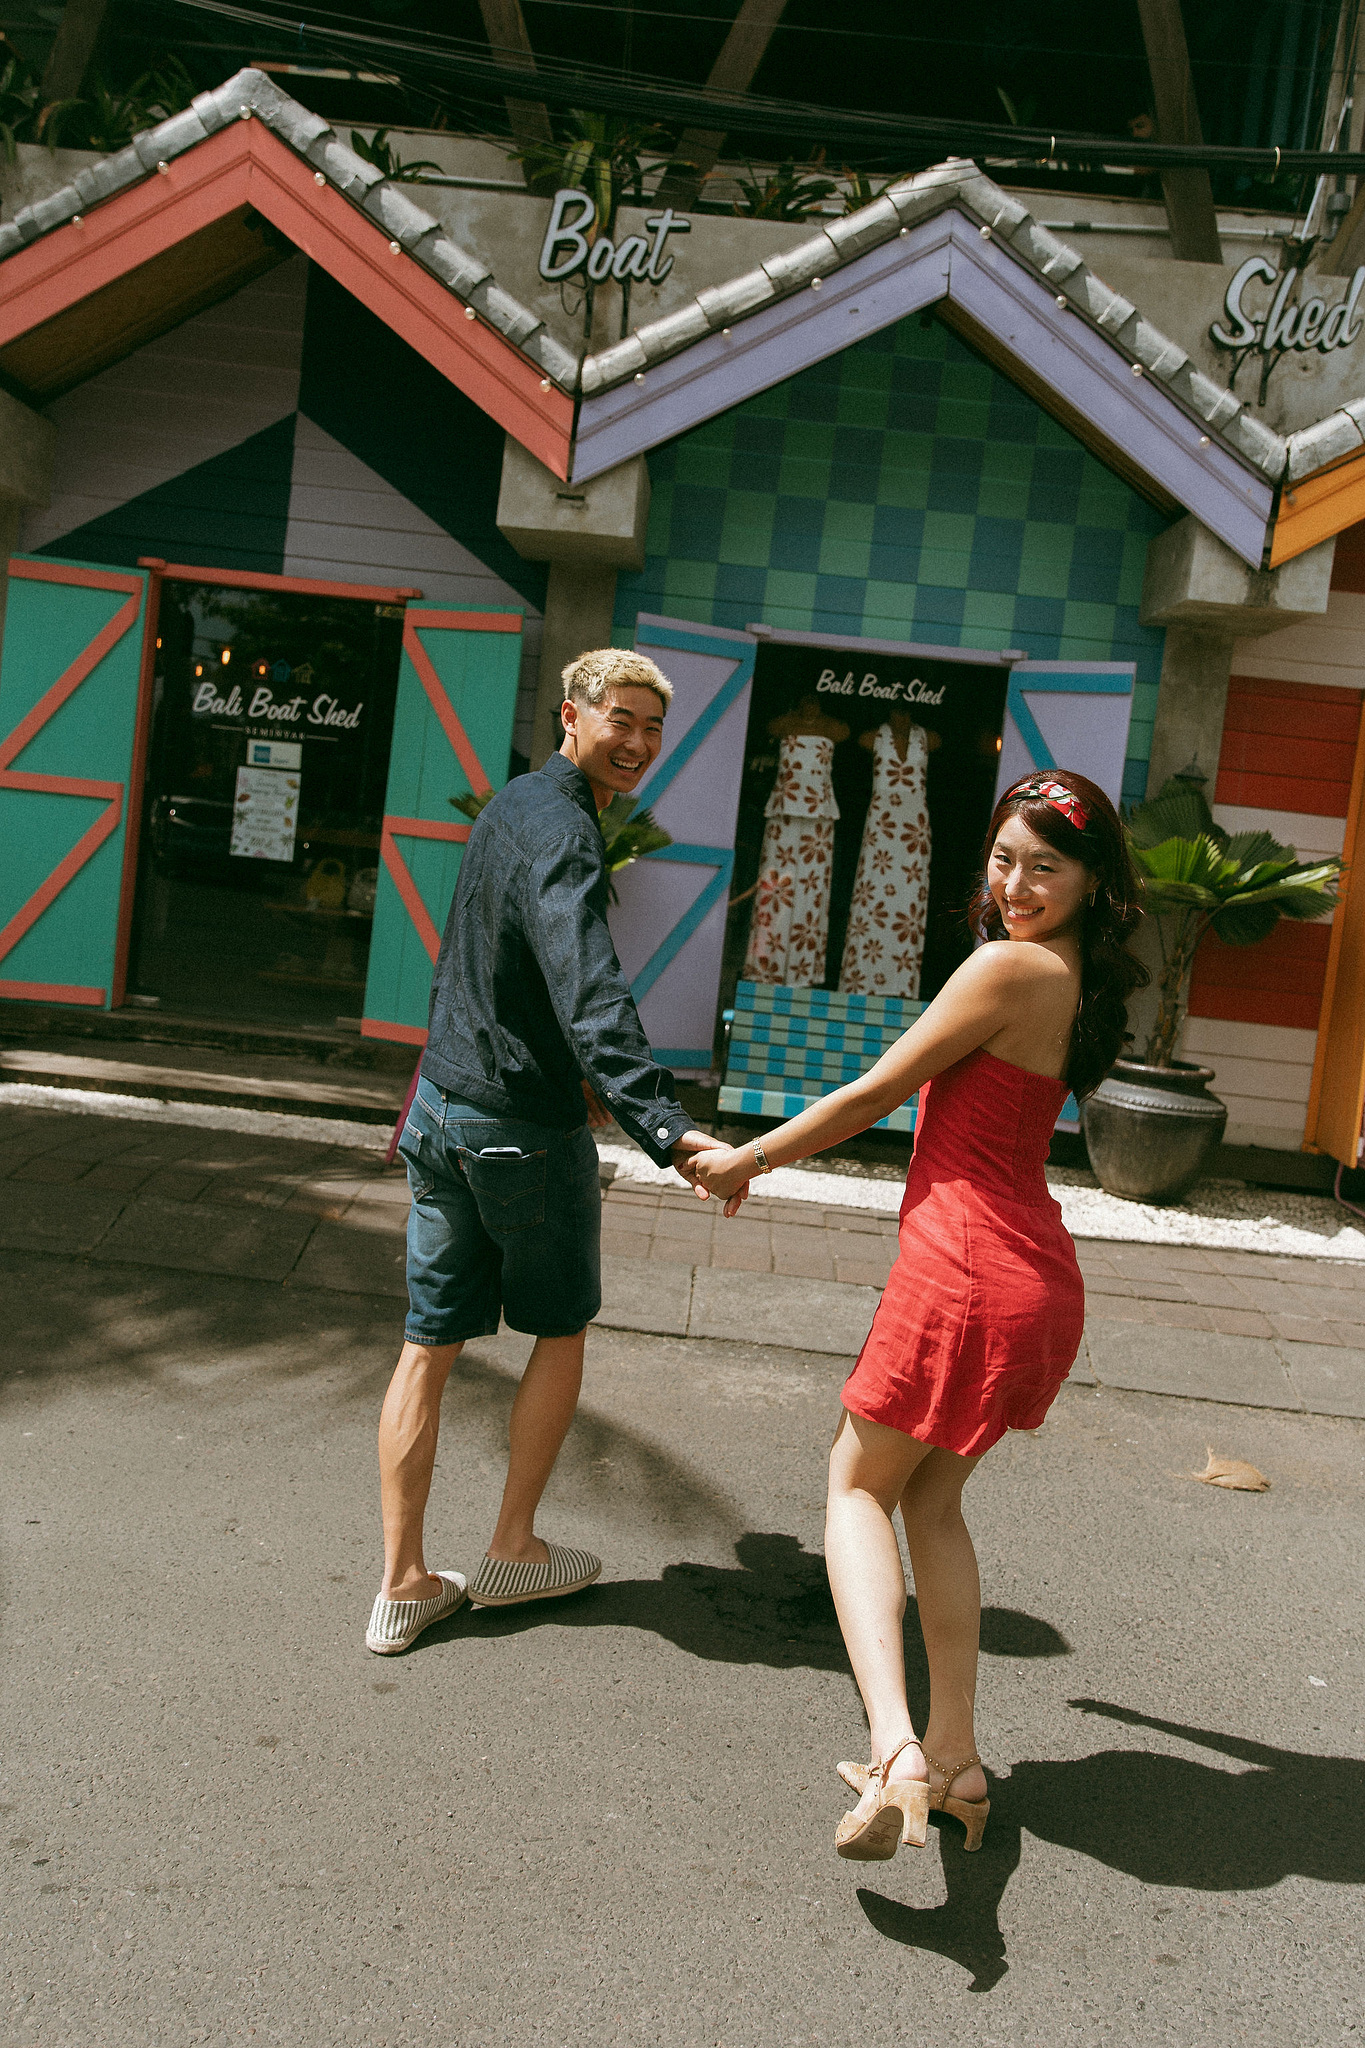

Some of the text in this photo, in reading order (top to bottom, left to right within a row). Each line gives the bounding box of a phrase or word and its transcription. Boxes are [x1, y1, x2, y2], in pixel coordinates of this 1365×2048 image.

[539, 189, 1365, 352] Boat Shed
[192, 682, 363, 728] Bali Boat Shed
[816, 669, 946, 705] Bali Boat Shed
[244, 726, 305, 740] SEMINYAK
